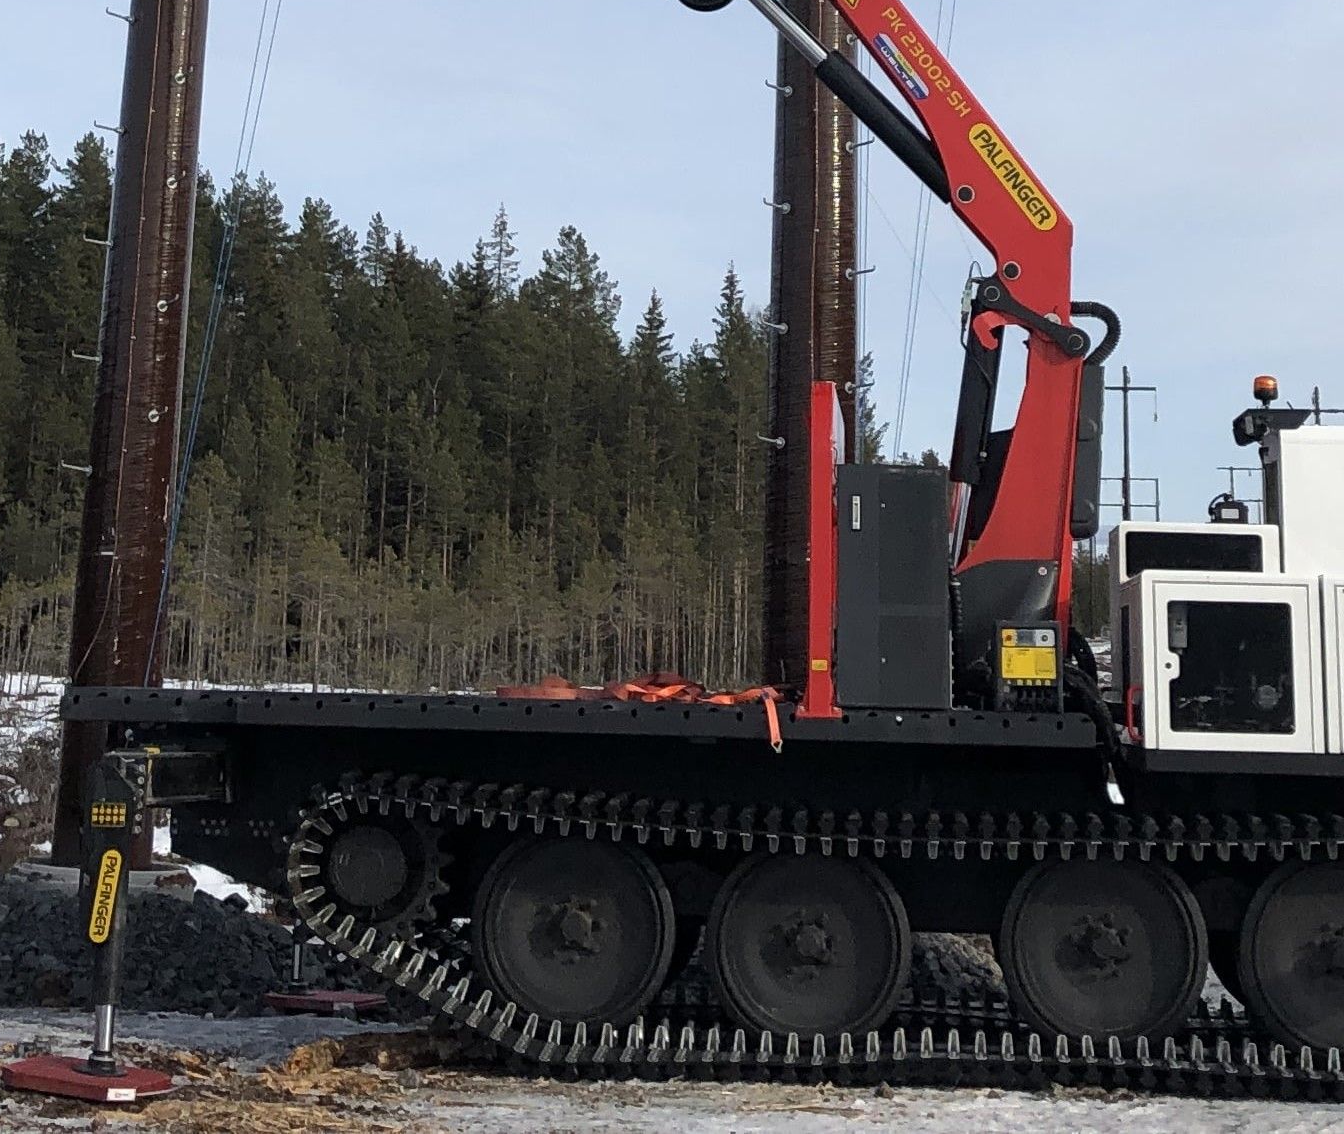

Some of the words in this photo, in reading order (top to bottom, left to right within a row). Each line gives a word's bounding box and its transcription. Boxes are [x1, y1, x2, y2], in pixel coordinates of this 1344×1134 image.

[881, 7, 907, 34] PK
[972, 128, 1053, 227] PALFINGER
[93, 855, 118, 937] PALFINGER
